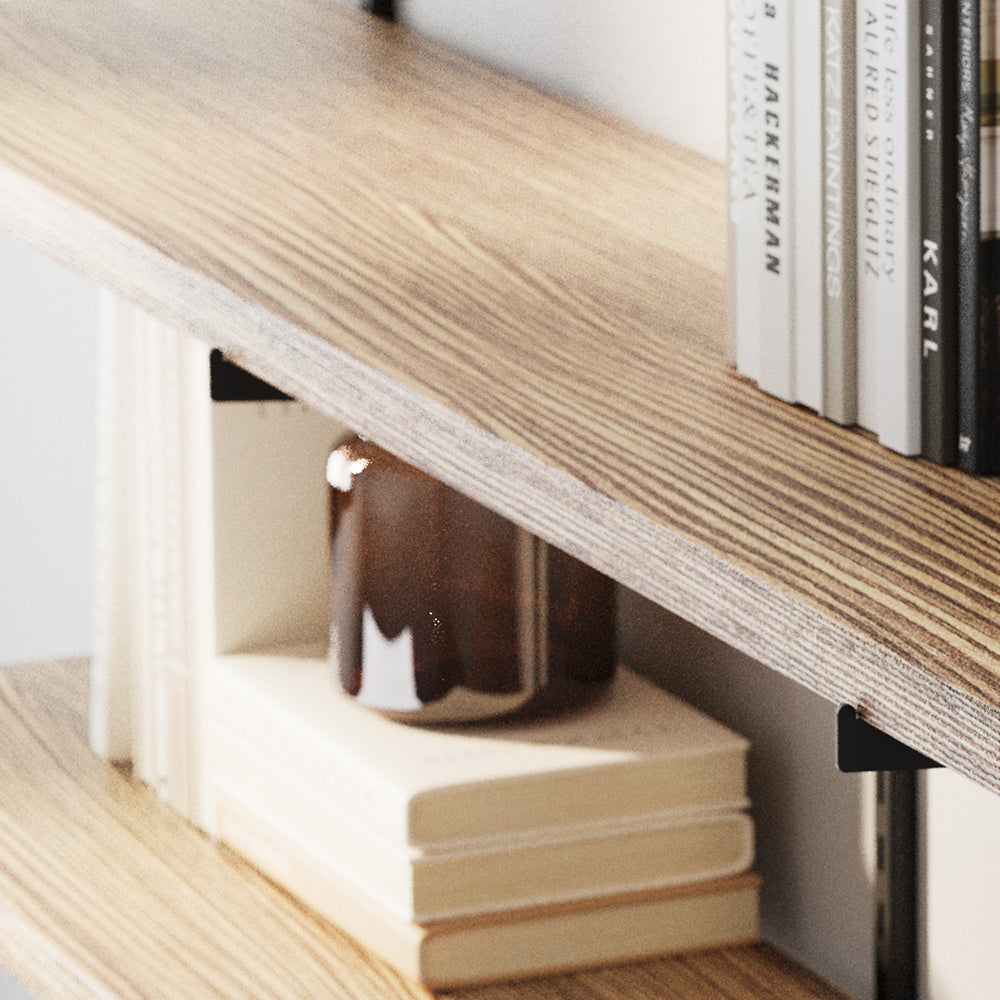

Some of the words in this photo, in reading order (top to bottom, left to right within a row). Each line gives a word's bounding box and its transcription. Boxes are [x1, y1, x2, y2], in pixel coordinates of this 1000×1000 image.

[825, 6, 841, 98] KATZ
[863, 8, 879, 122] ALFRED
[883, 2, 899, 55] life
[883, 66, 899, 124] less
[764, 62, 780, 275] HACKERMAN
[825, 107, 842, 297] PAINTINGS
[863, 134, 879, 279] STIEGLITZ
[881, 136, 899, 284] ordinary
[922, 239, 939, 358] KARL
